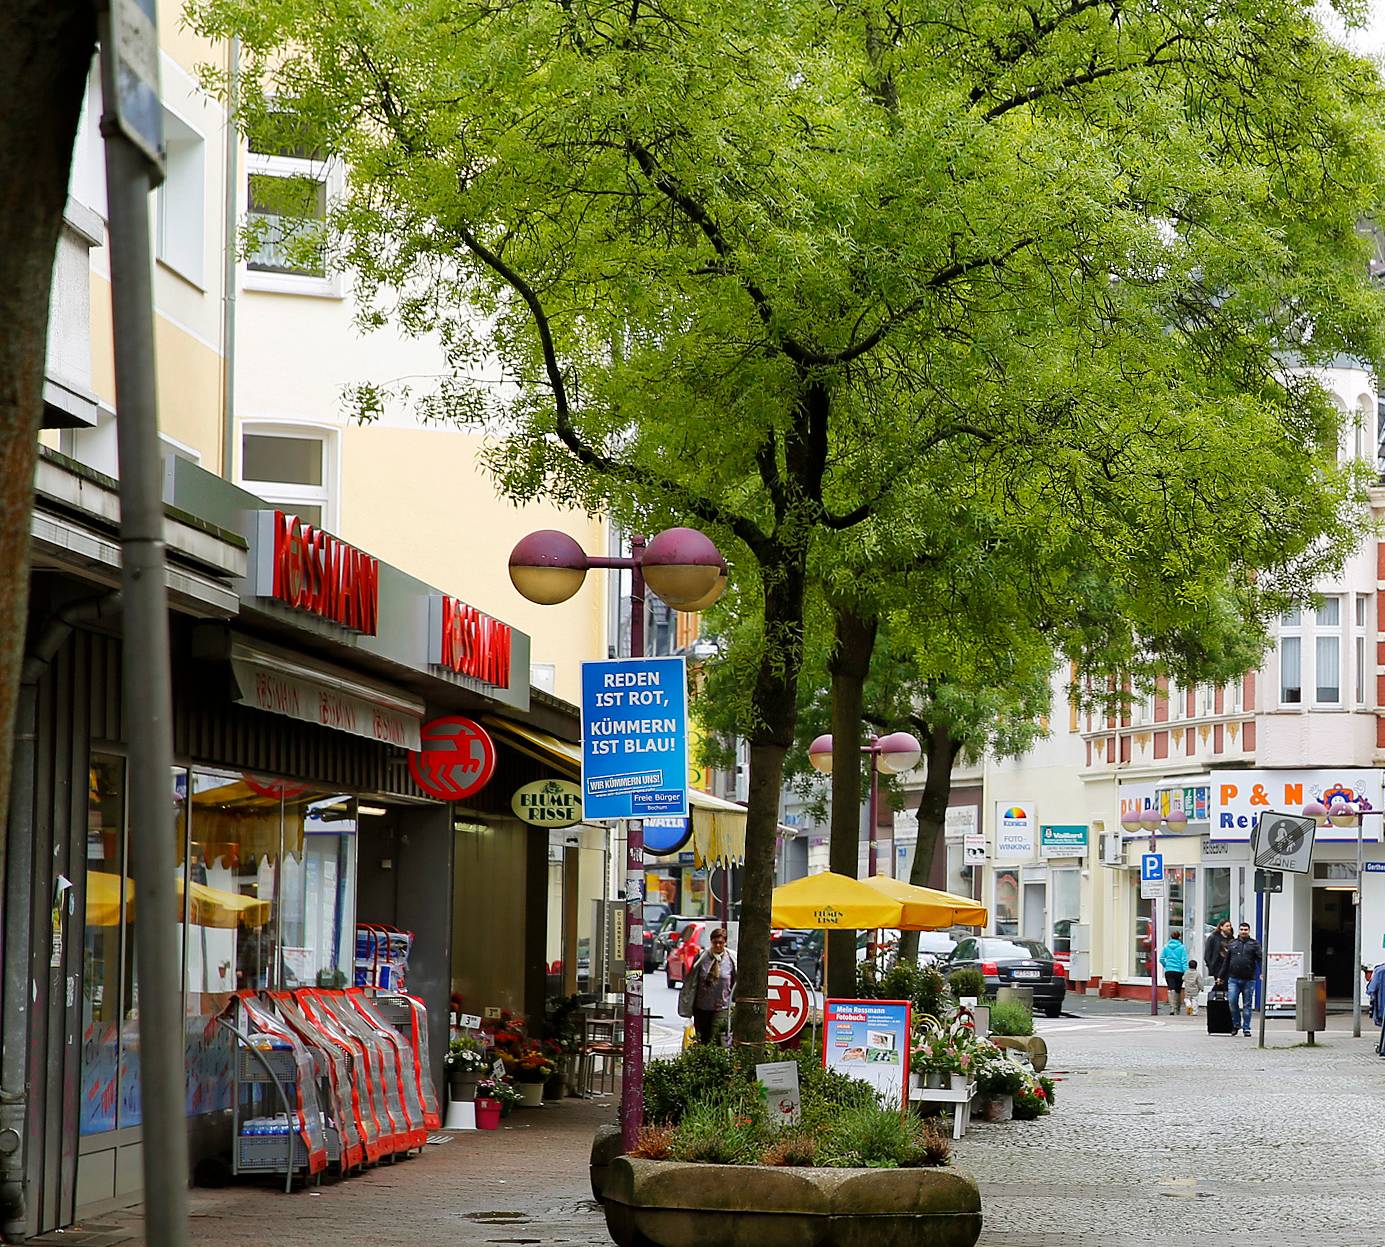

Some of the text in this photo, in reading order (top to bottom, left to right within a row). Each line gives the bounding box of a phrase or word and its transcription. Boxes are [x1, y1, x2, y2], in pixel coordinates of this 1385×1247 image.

[273, 507, 378, 637] ROSSMANN
[442, 594, 511, 689] ROSSMANN
[604, 672, 660, 688] REDEN
[596, 690, 669, 707] IST ROT,
[591, 718, 676, 736] KÜMMERN
[591, 738, 676, 755] IST BLAU!
[590, 774, 661, 791] WIR KÜMMERN UNS!
[634, 793, 681, 802] Freie Bürger
[1220, 785, 1238, 806] P
[1250, 784, 1270, 806] &
[1284, 784, 1303, 805] N
[528, 808, 575, 820] RISSE
[1220, 812, 1260, 828] Rei
[1146, 857, 1158, 878] P
[1269, 857, 1296, 869] ZONE
[837, 1006, 852, 1014] Mein
